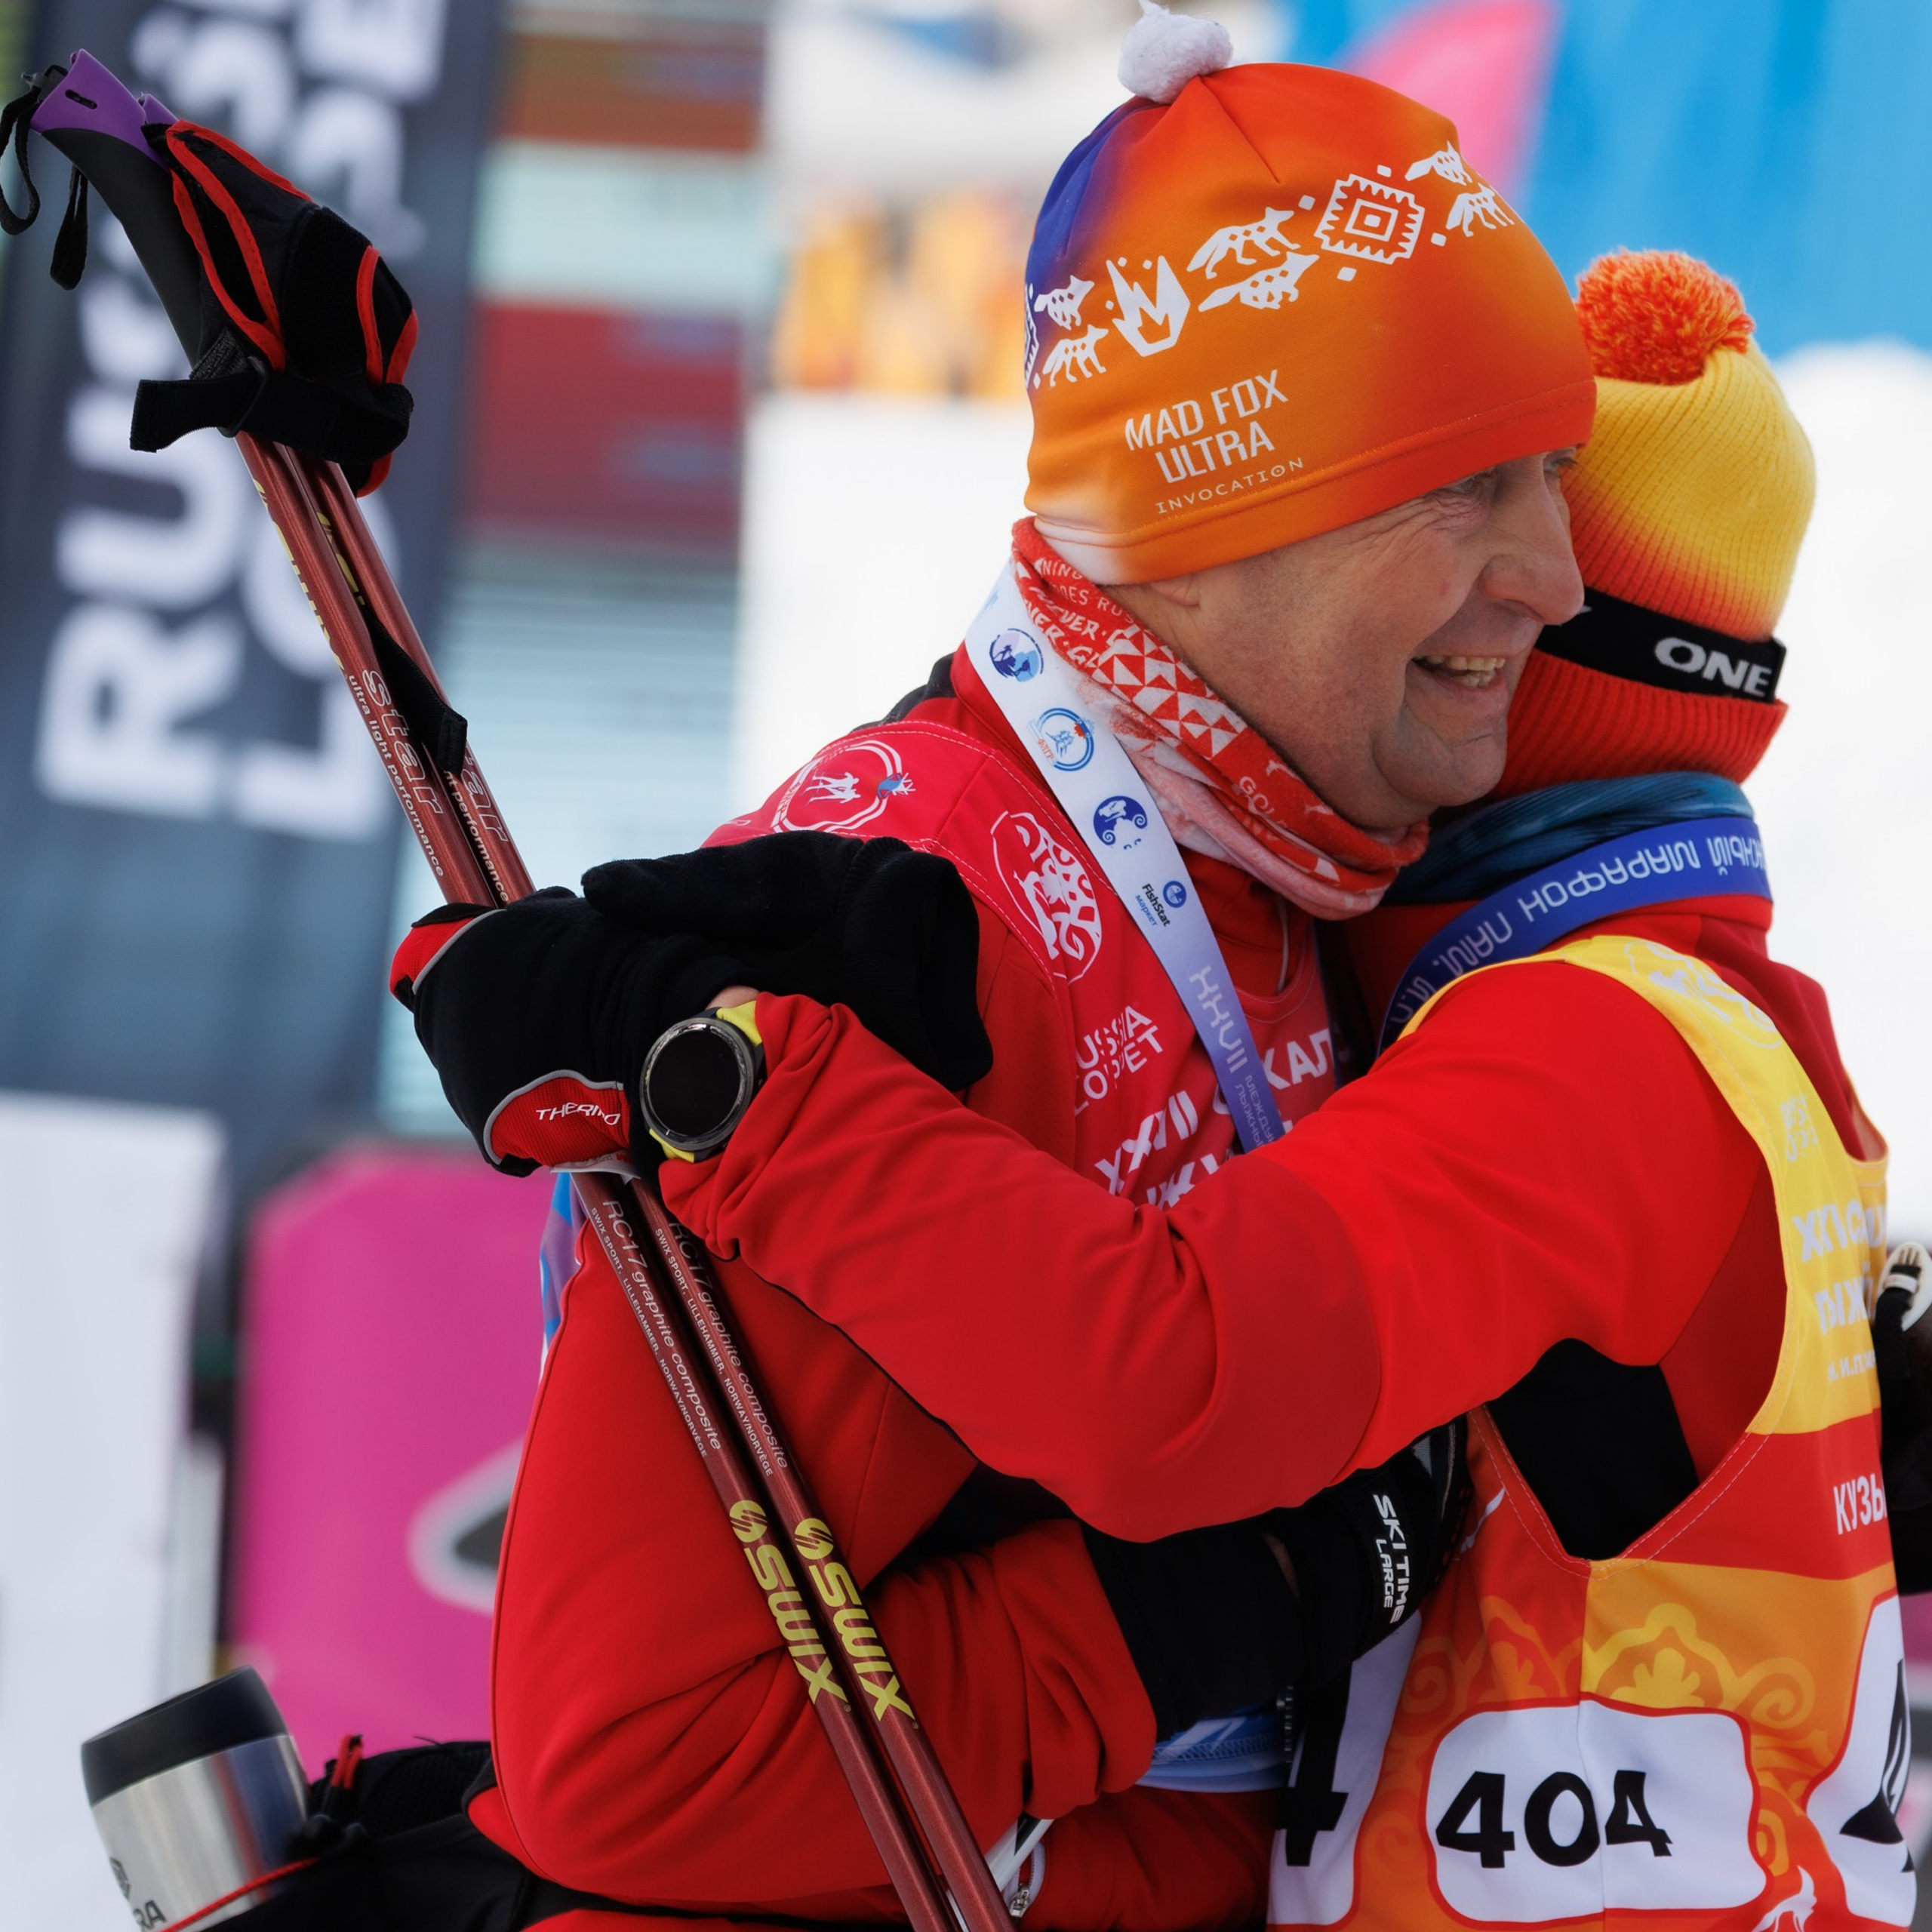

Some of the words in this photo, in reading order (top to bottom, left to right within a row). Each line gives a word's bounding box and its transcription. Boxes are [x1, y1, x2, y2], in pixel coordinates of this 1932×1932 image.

[1124, 399, 1204, 451] MAD
[1211, 369, 1289, 425] FOX
[1155, 420, 1275, 484] ULTRA
[1155, 457, 1304, 515] INVOCATION
[1654, 636, 1773, 697] ONE
[349, 675, 371, 715] ultra
[368, 719, 392, 760] light
[387, 764, 444, 878] performance
[460, 747, 509, 843] ar
[451, 789, 510, 903] performance
[1135, 894, 1158, 927] маркет
[1142, 883, 1171, 928] FishStat
[1518, 839, 1702, 923] МАРАФОН
[1075, 1005, 1153, 1069] USSIA
[1235, 1084, 1264, 1146] ЛЫЖНЫ
[591, 1207, 606, 1235] SWIX
[655, 1227, 672, 1255] SWIX
[602, 1199, 648, 1269] RC17
[632, 1270, 675, 1349] graphite
[671, 1352, 722, 1451] composite
[697, 1291, 742, 1368] graphite
[737, 1371, 789, 1469] composite
[1372, 1494, 1407, 1550] SKI
[1833, 1472, 1887, 1536] КУЗЬ
[1375, 1538, 1395, 1609] LARGE
[1389, 1555, 1410, 1624] TIME
[743, 1544, 849, 1706] SWIX
[808, 1561, 916, 1722] SWIX
[1435, 1769, 1674, 1869] 404
